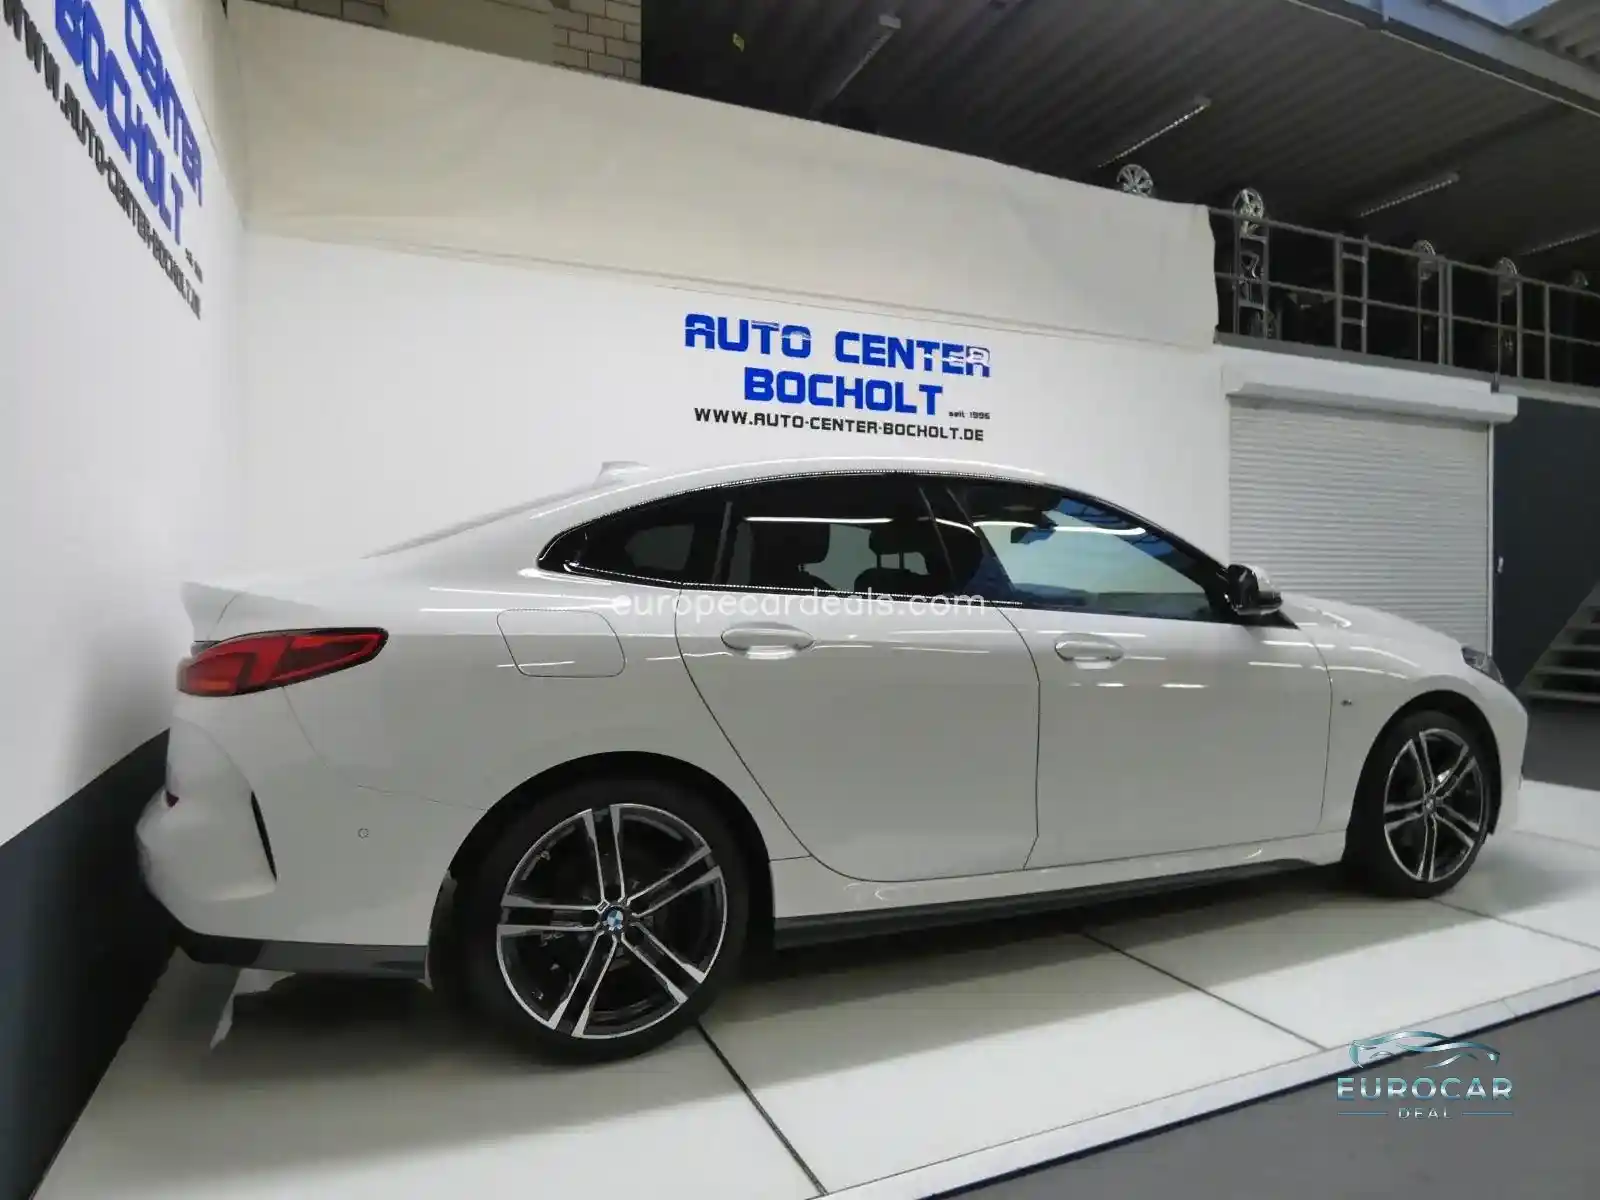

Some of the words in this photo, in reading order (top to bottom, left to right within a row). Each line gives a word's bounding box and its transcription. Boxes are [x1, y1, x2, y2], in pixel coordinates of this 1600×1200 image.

[55, 0, 184, 246] BOCHOLT
[125, 0, 203, 208] CENTER
[684, 313, 811, 358] AUTO
[835, 330, 991, 378] CENTER
[744, 366, 943, 416] BOCHOLT
[693, 407, 984, 441] WWW.AUTO-CENTER-BOCHOLT.DE
